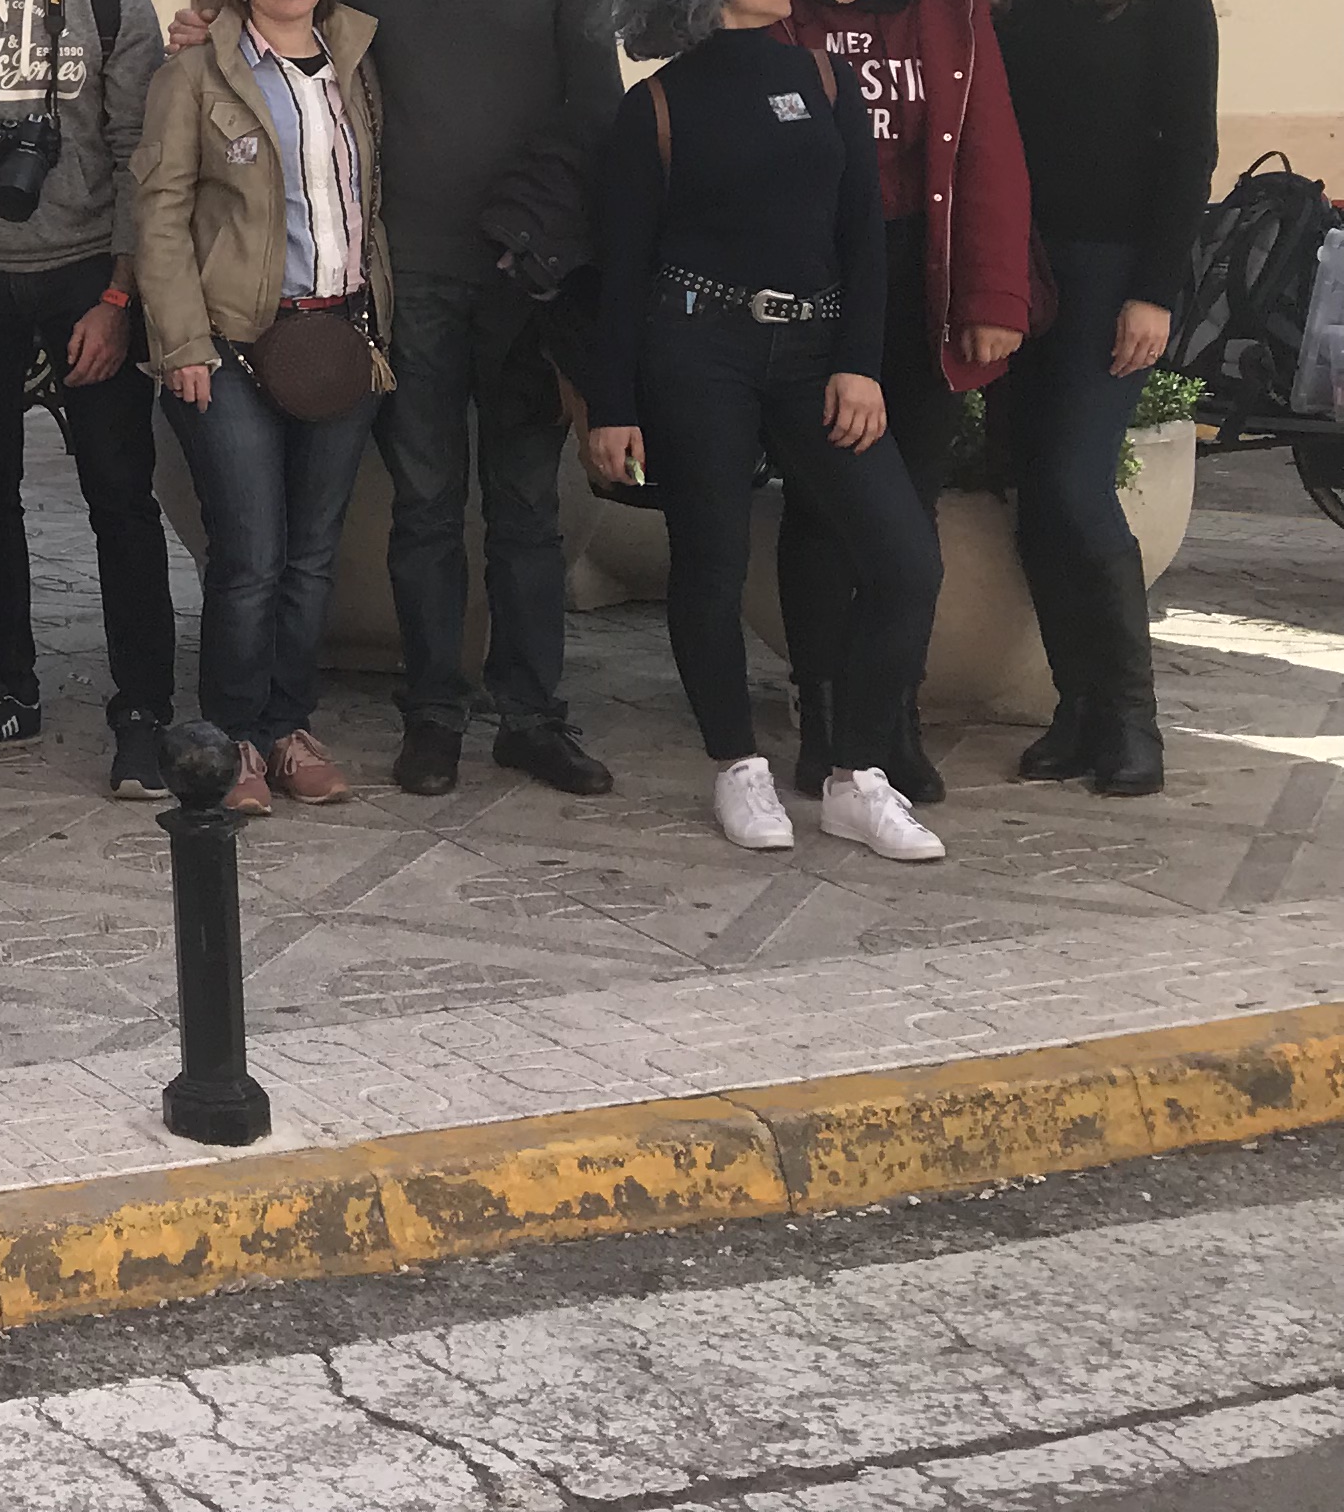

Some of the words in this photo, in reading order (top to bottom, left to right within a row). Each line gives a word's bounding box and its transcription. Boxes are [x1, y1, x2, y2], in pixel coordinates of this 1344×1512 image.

[7, 34, 19, 48] &
[826, 32, 873, 55] ME?
[59, 47, 84, 57] 1990
[0, 42, 87, 89] Jones
